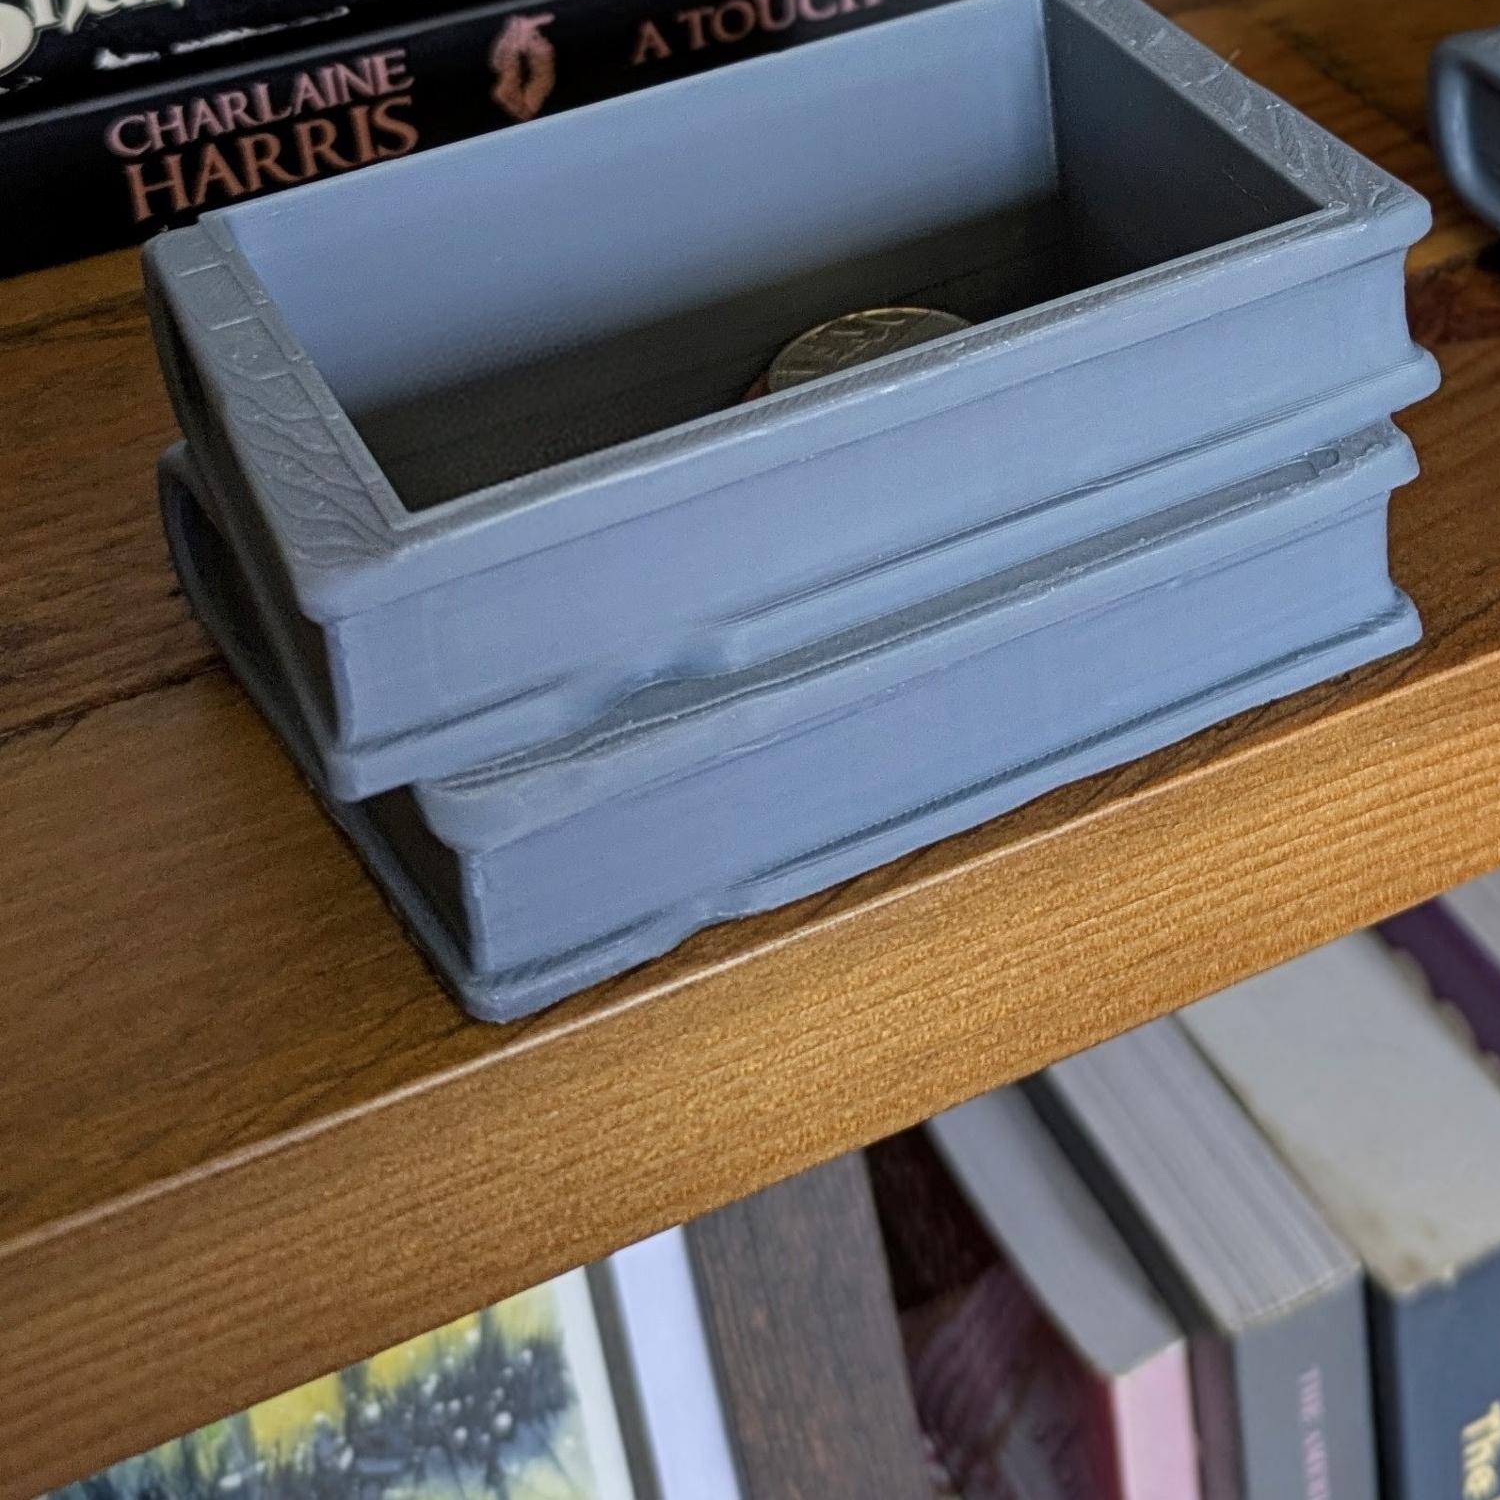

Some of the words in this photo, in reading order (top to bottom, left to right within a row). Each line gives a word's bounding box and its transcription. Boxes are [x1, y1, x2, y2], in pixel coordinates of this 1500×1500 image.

[632, 21, 671, 66] A
[107, 48, 416, 158] CHARLAINE
[125, 95, 421, 222] HARRIS
